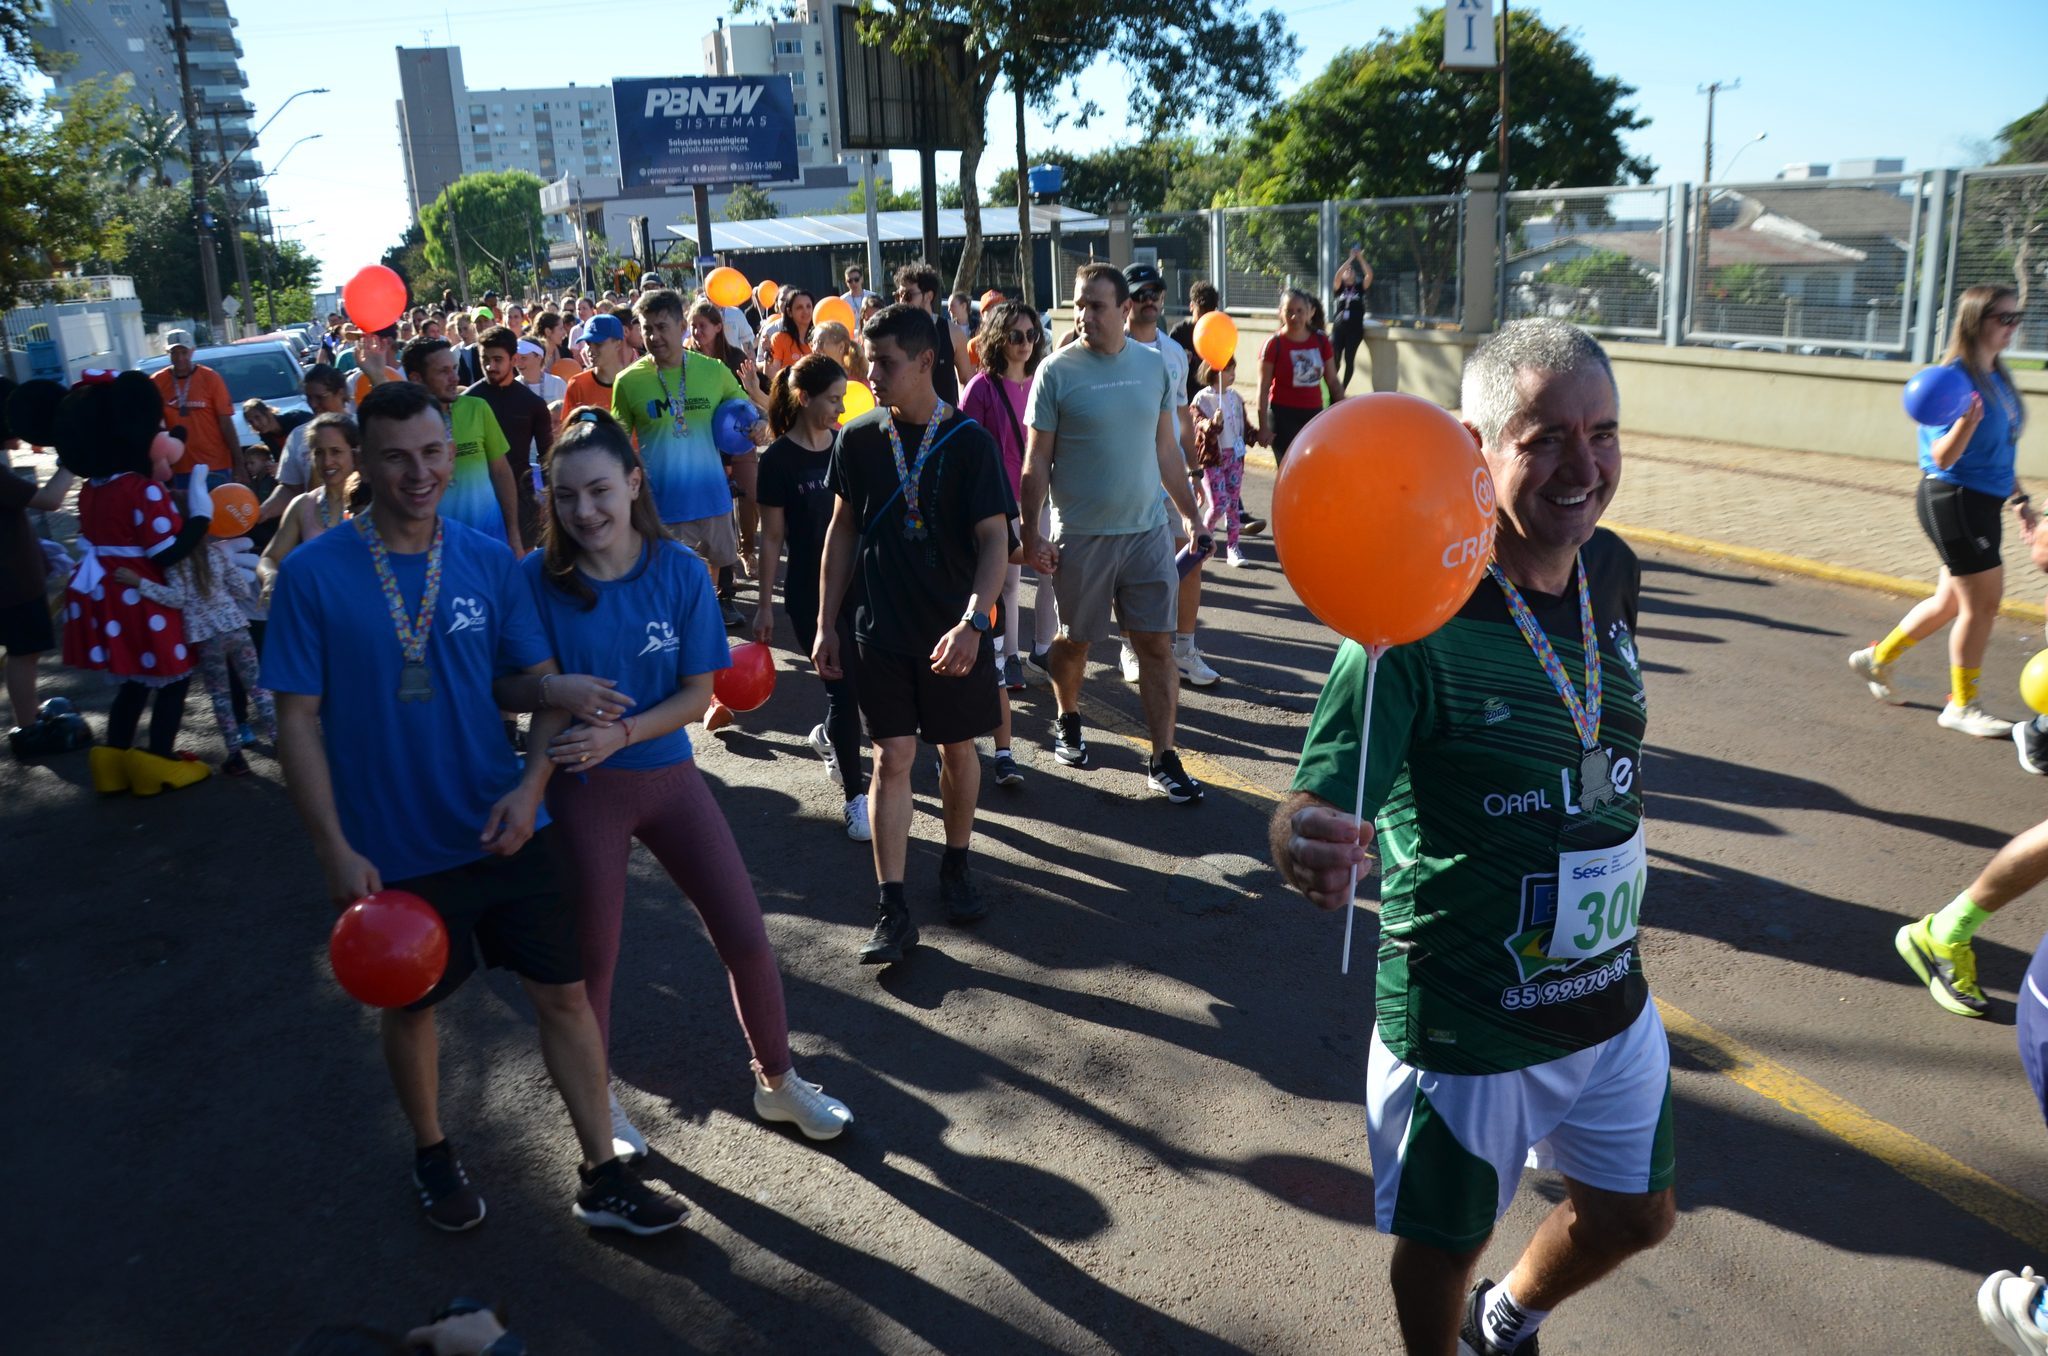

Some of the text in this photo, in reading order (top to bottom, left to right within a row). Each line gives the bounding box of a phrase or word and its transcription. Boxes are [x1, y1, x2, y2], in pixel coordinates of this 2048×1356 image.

[1458, 0, 1483, 52] I
[644, 85, 764, 118] PBNEW
[675, 115, 767, 130] SISTEMAS
[668, 135, 749, 148] Soluções tecnológicas
[681, 145, 713, 155] produtos
[1484, 789, 1551, 816] ORAL
[1561, 748, 1633, 815] Le
[1572, 864, 1608, 880] Sesc
[1502, 984, 1540, 1009] 55
